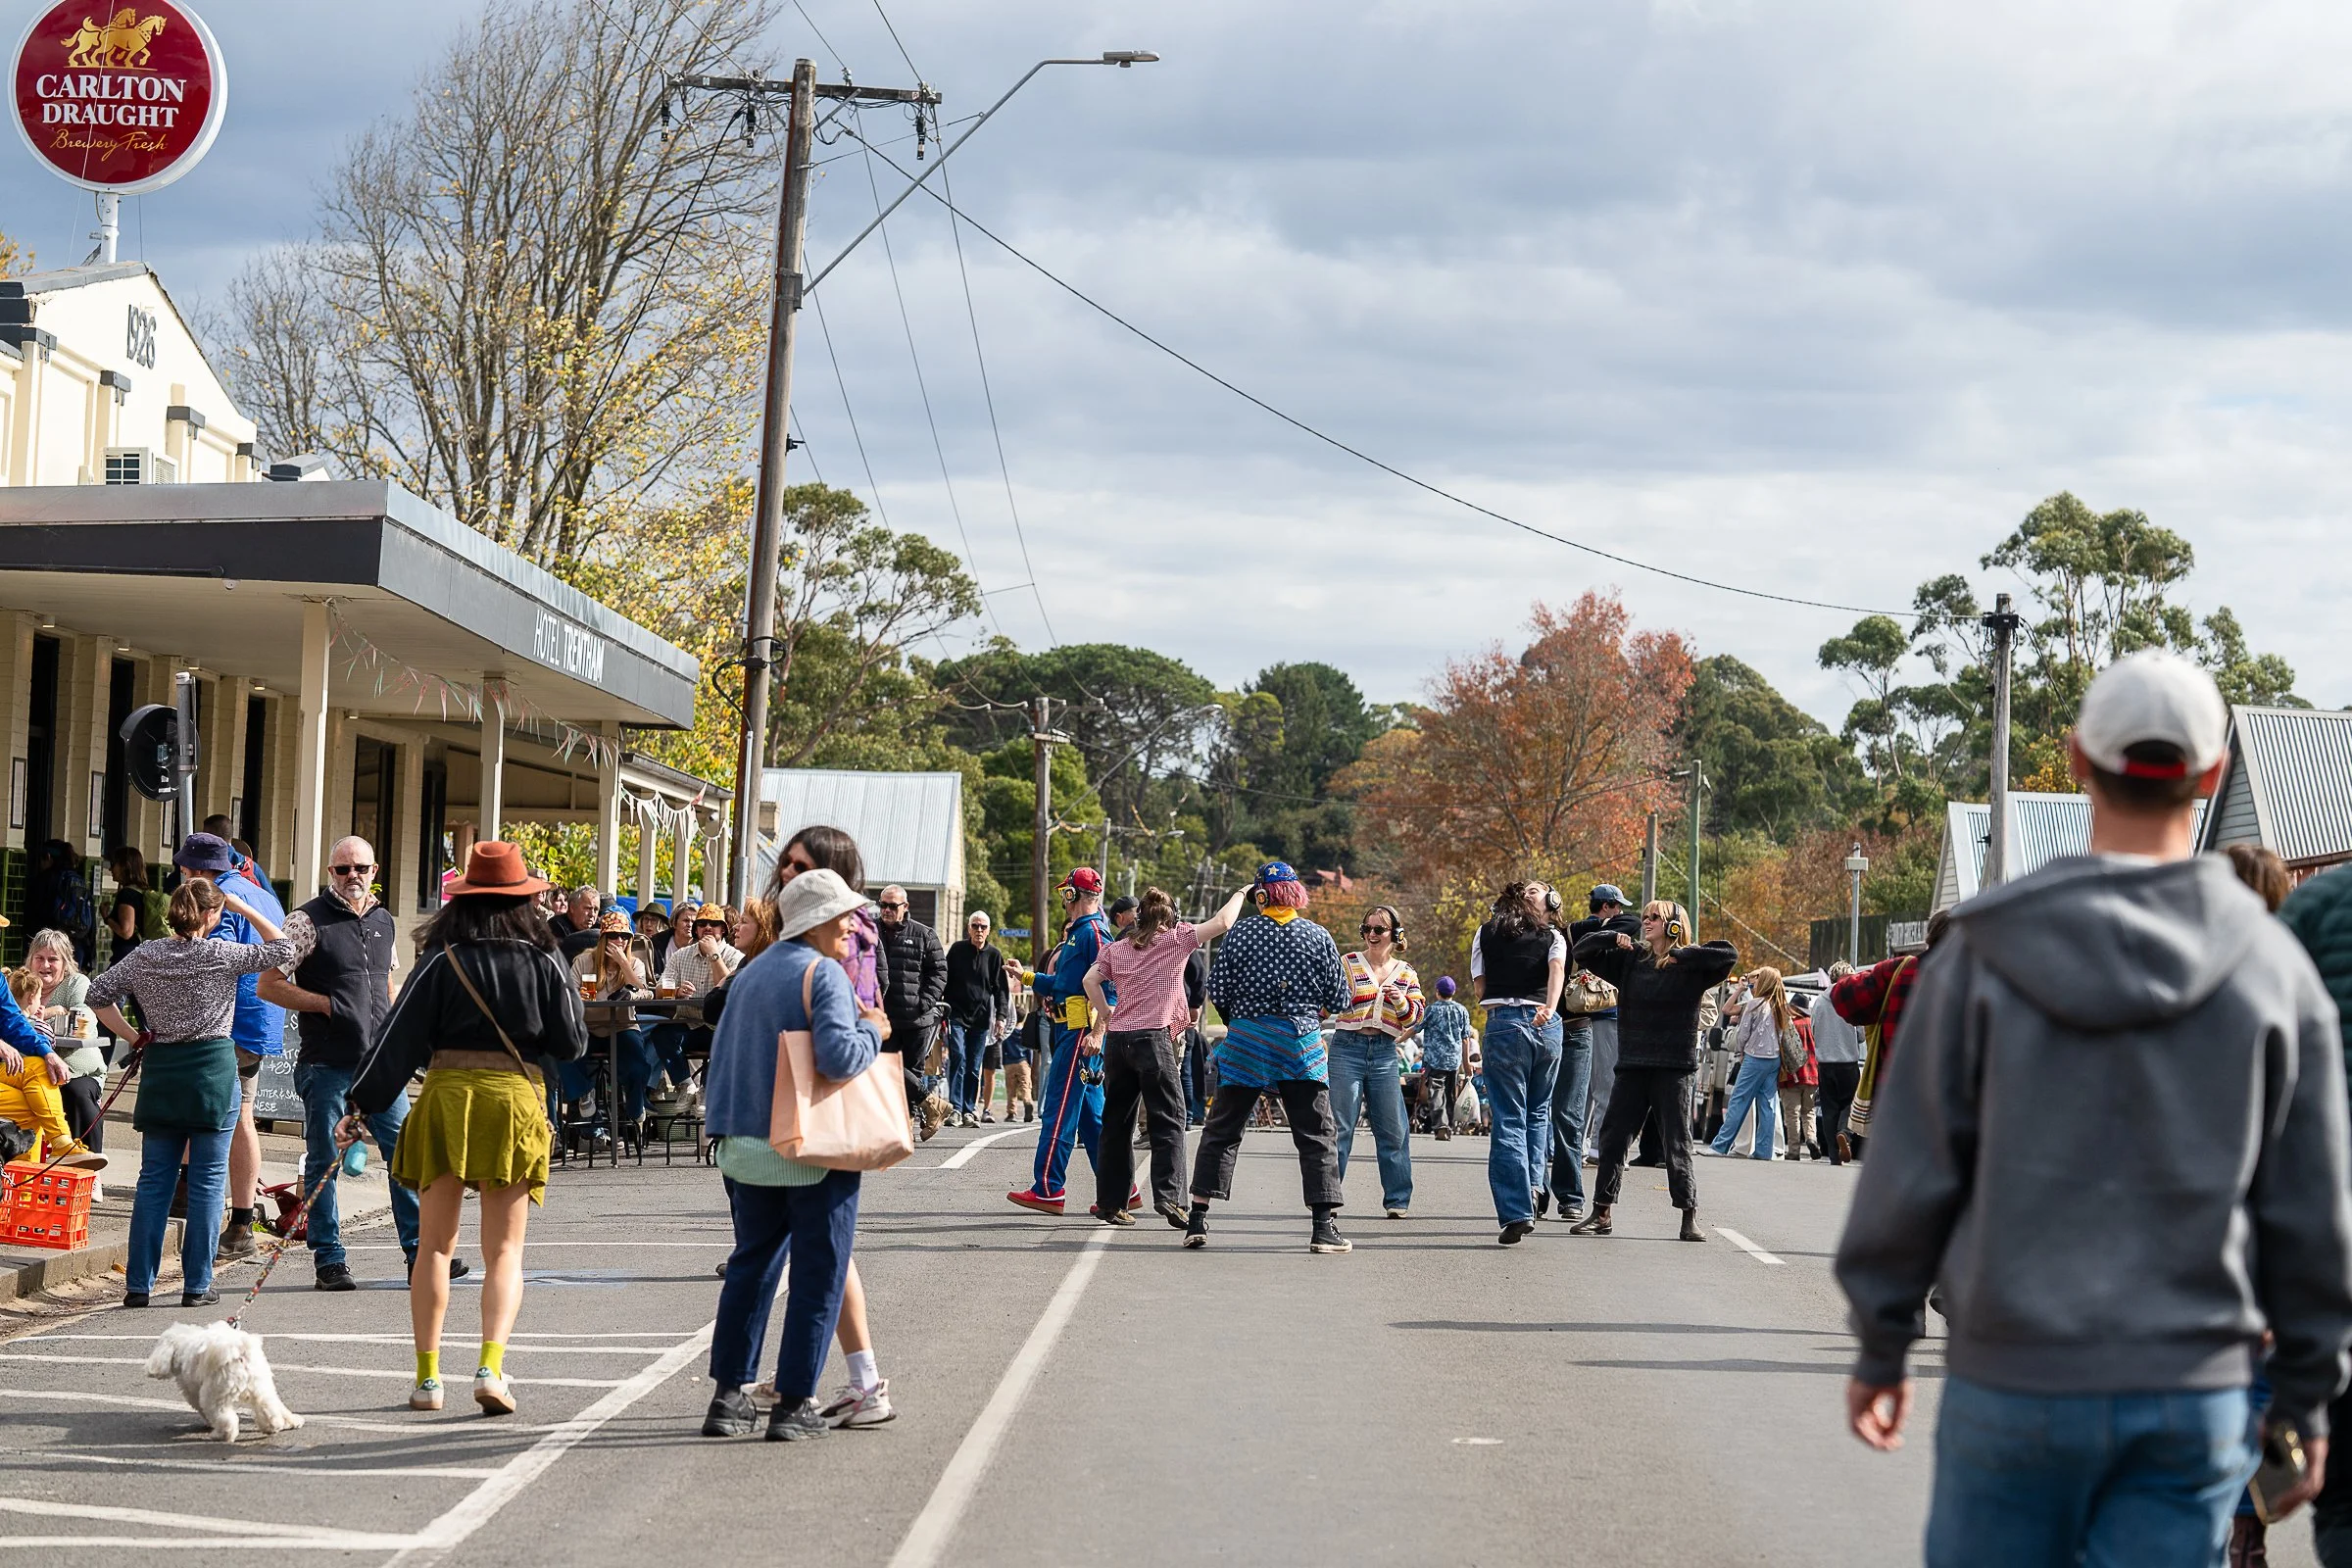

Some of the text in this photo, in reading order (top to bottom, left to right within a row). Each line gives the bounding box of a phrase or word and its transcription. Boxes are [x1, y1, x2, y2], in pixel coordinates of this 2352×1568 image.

[36, 74, 186, 102] CARLTON
[42, 103, 178, 127] DRAUGHT
[49, 129, 167, 161] Brewery Fresh
[126, 304, 157, 369] 1926
[533, 609, 606, 683] HOTEL TRENTHAM
[255, 1088, 279, 1099] UTTER
